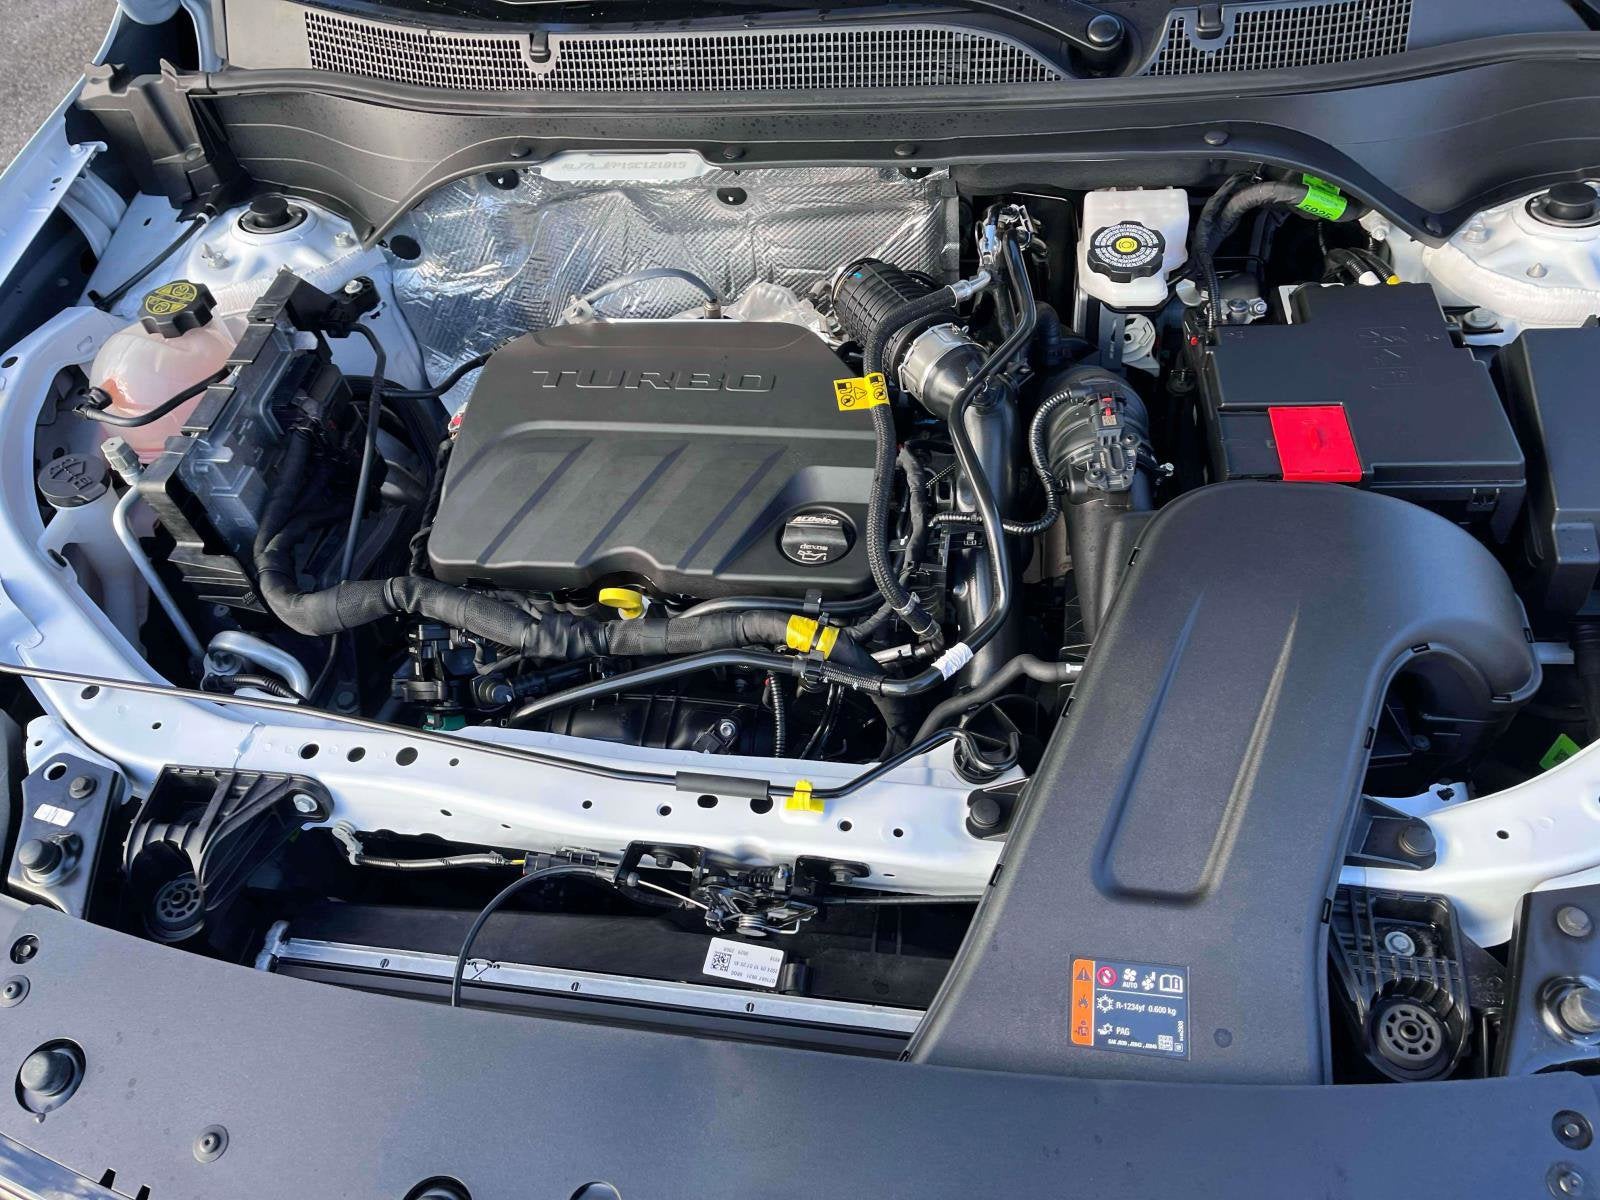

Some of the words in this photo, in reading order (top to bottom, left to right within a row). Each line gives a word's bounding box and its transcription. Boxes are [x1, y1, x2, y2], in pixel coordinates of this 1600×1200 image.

[532, 369, 776, 393] TURBO
[792, 516, 839, 525] ACDelco
[1122, 981, 1138, 989] AUTO
[1116, 1001, 1145, 1013] R-1234yf
[1148, 1004, 1167, 1014] 0.600
[1167, 1006, 1177, 1017] kg
[1116, 1026, 1130, 1036] PAG
